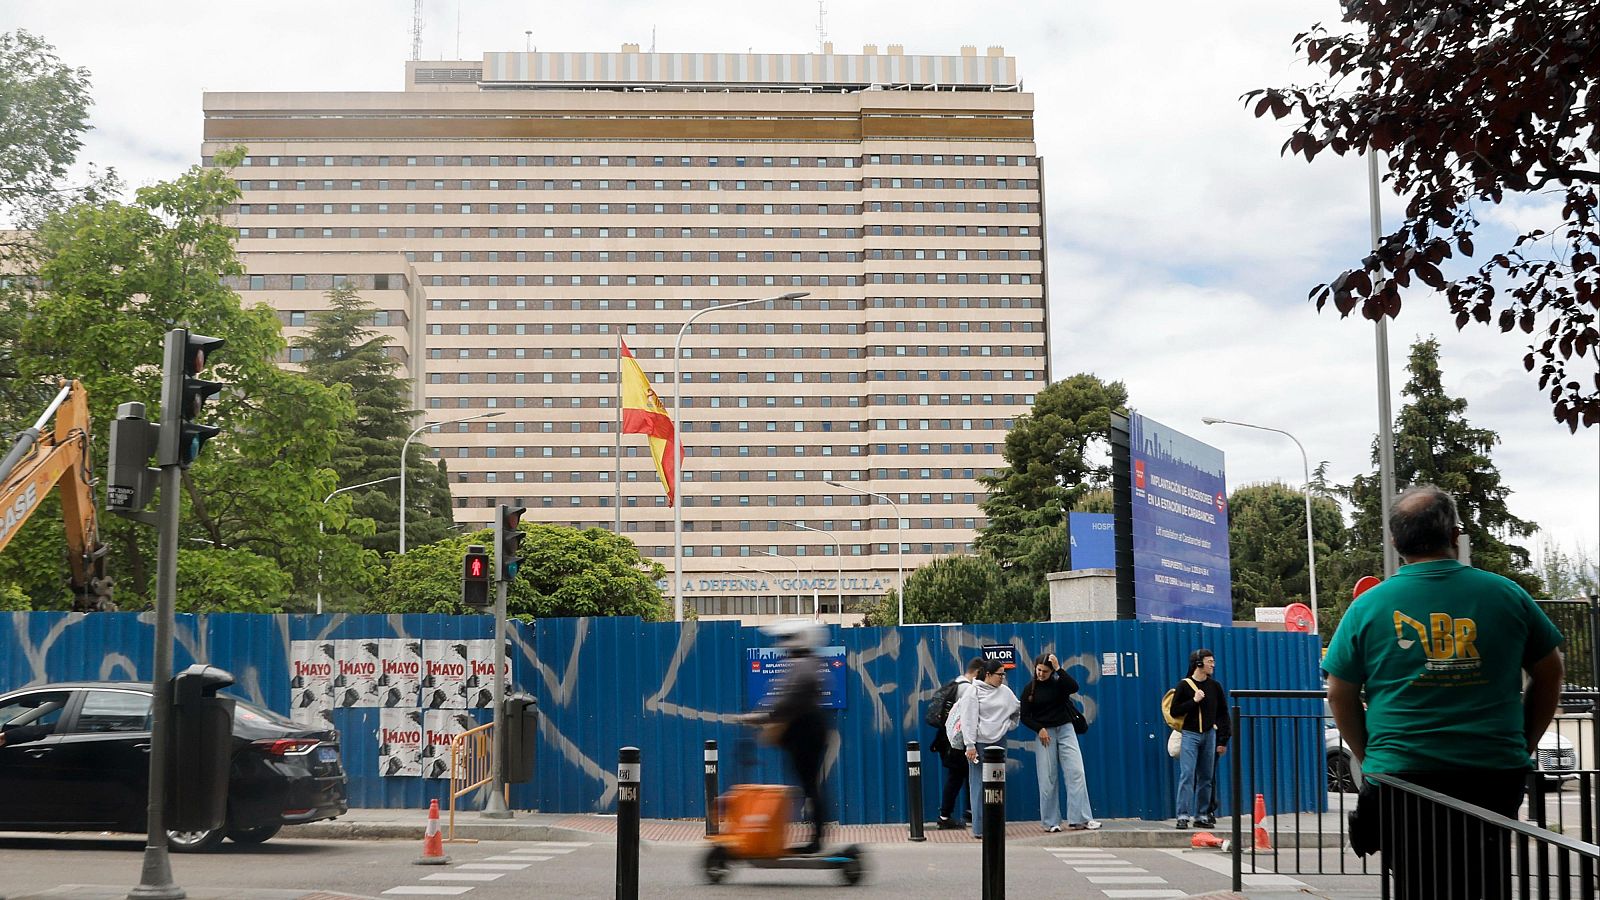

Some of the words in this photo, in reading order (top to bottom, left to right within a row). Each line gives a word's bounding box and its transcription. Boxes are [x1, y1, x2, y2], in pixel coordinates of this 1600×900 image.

[1147, 494, 1154, 505] EN
[1154, 496, 1161, 507] LA
[699, 579, 770, 591] DEFENSA
[1430, 612, 1480, 659] BR
[985, 650, 1012, 660] VILOR
[705, 764, 716, 774] TM54
[908, 767, 920, 776] TM54
[618, 786, 637, 801] TM54
[984, 789, 1003, 804] TM54
